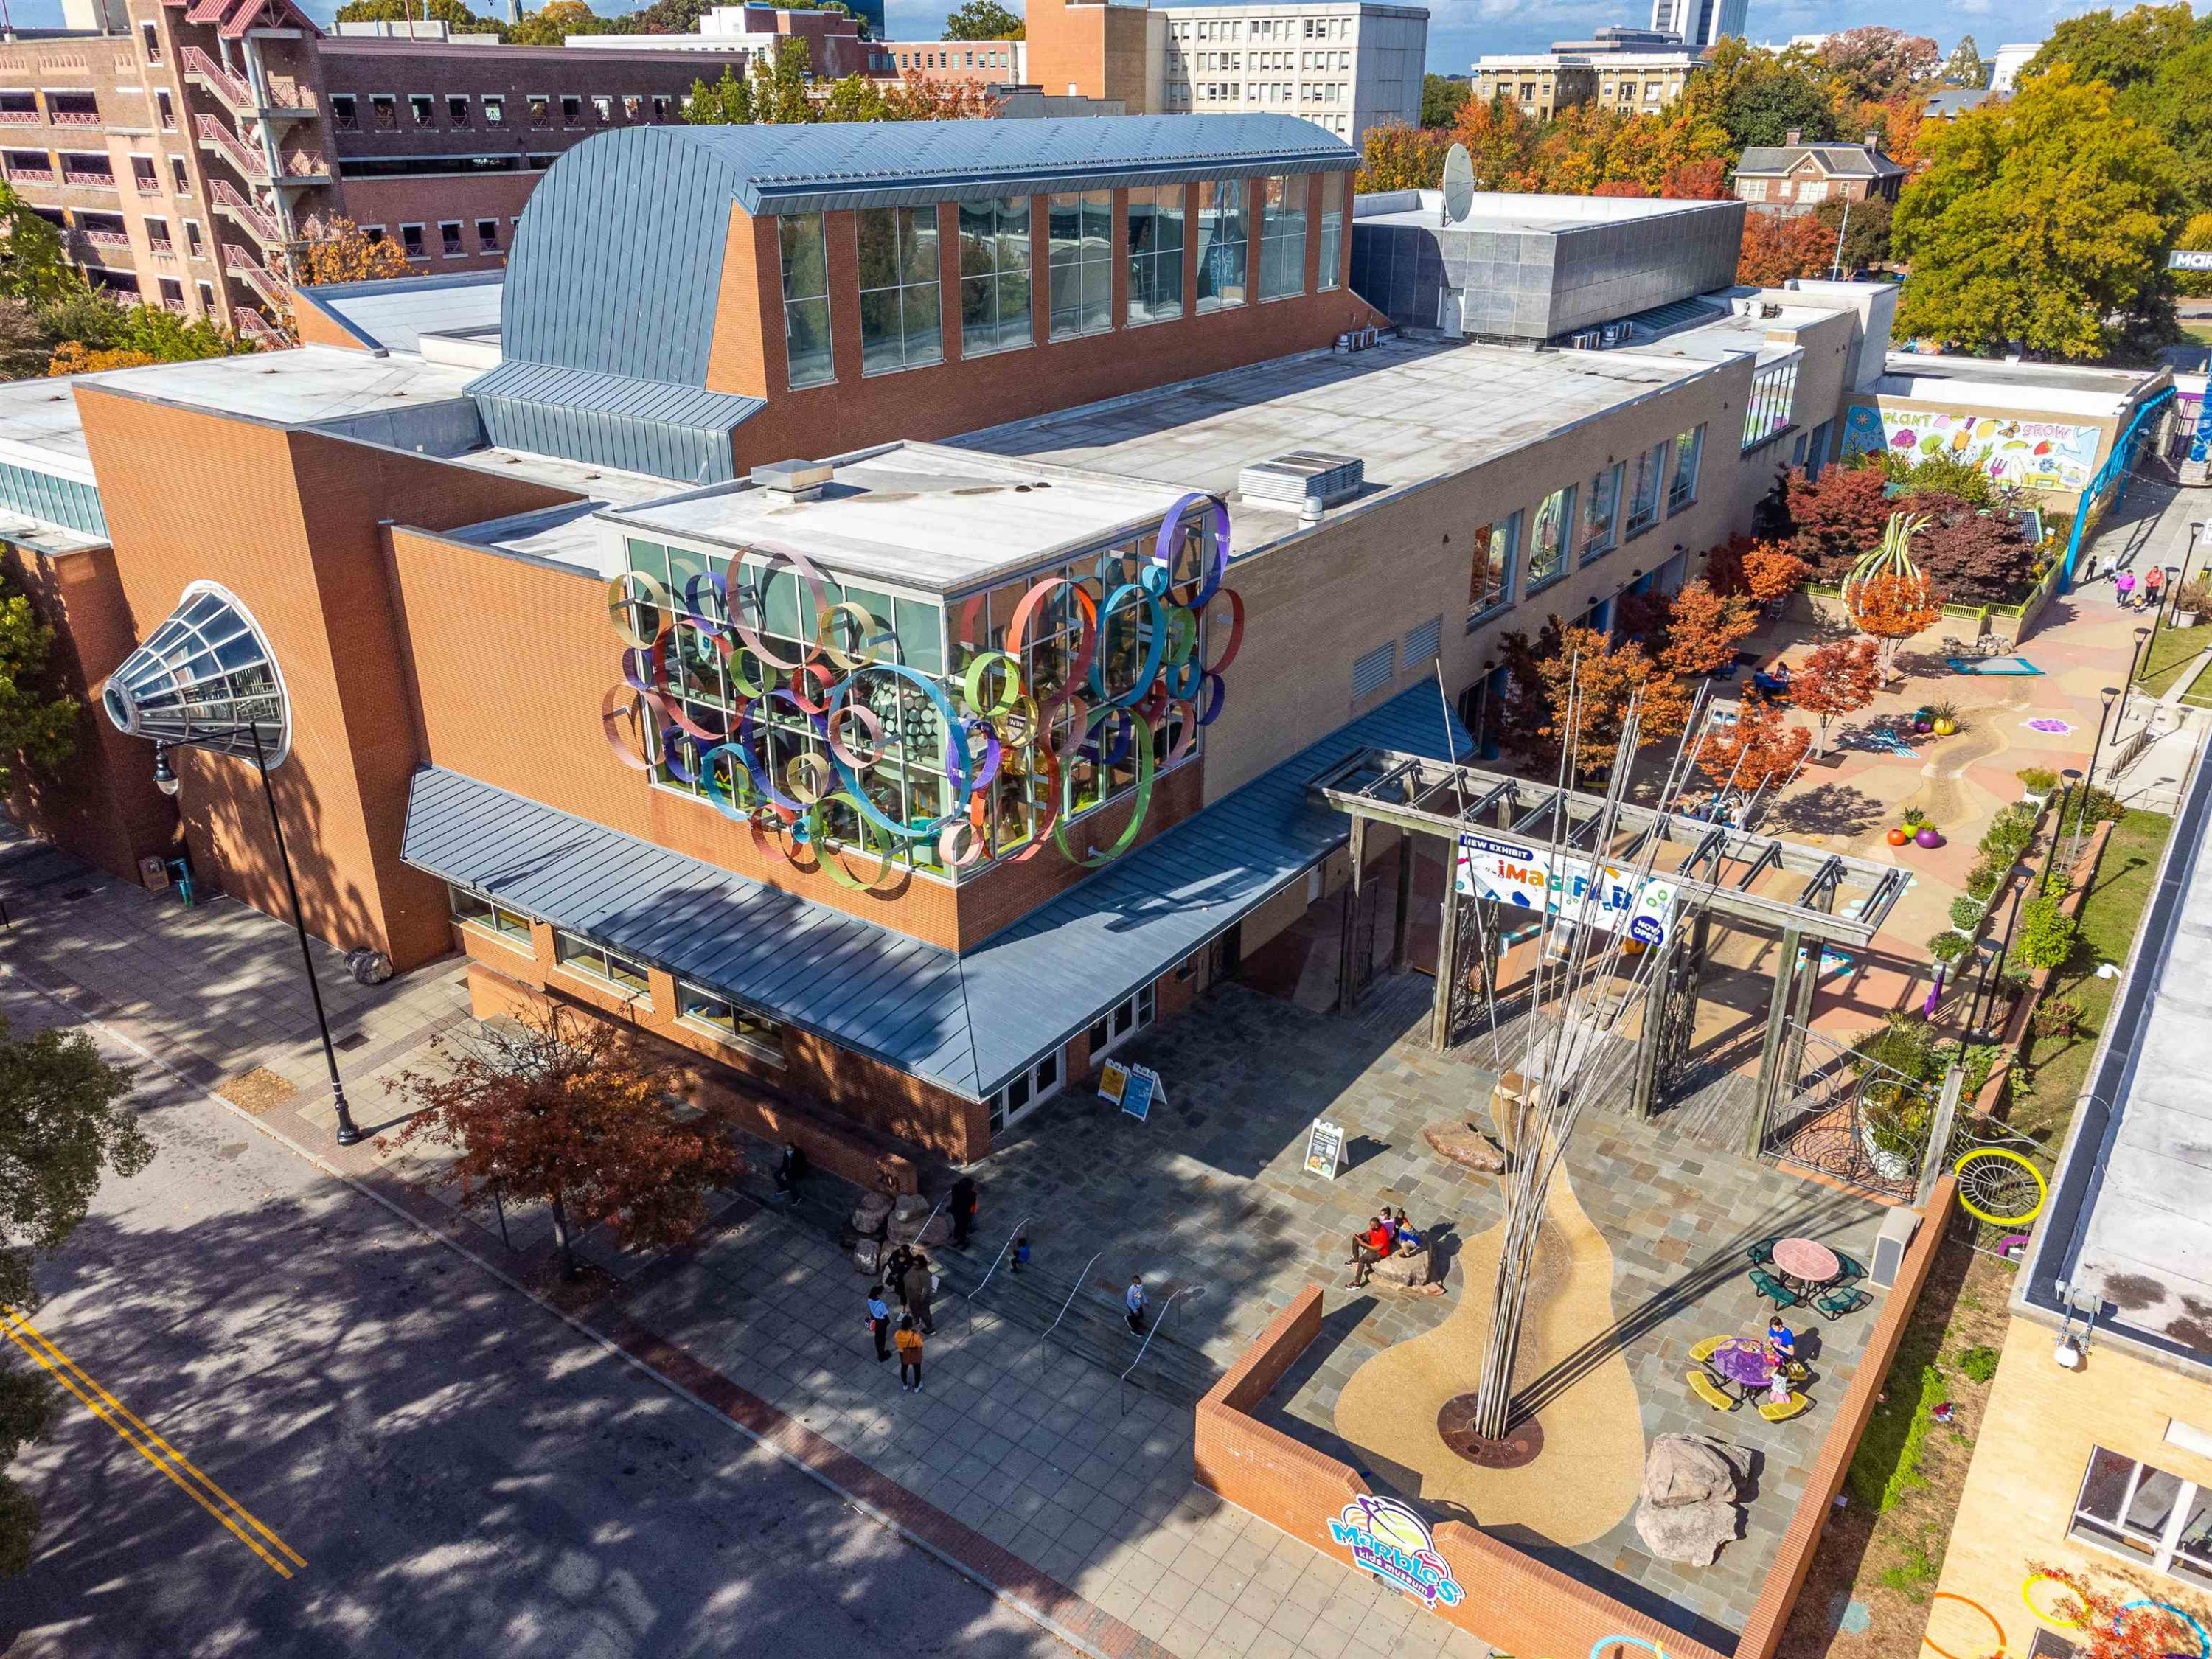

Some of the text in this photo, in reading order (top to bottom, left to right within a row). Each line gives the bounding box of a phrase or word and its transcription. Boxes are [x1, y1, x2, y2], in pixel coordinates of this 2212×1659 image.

[1464, 838, 1529, 859] NEW EXHIBIT
[1637, 919, 1660, 935] NOW
[1359, 1548, 1429, 1596] kids museum
